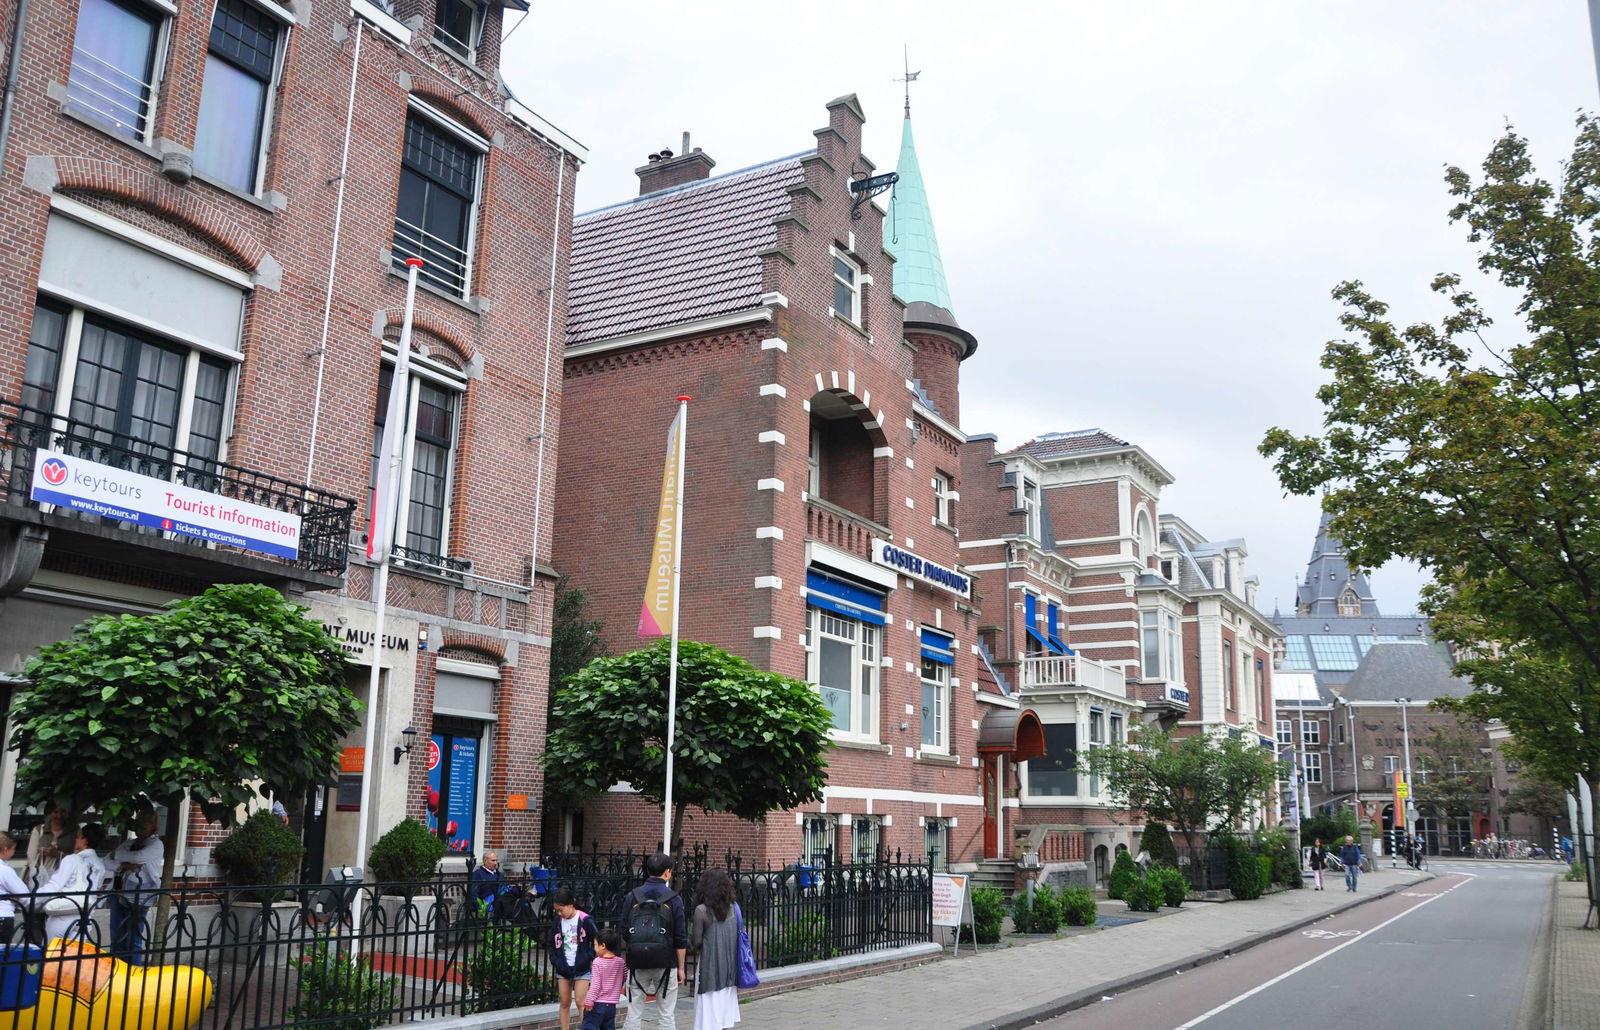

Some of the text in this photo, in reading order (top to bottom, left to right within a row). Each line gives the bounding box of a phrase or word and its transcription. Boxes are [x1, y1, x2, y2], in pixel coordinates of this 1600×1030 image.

[74, 468, 143, 499] keytours
[70, 499, 140, 521] www.keytours.nl
[165, 492, 297, 537] Tourist information
[175, 523, 247, 546] tickets & excursions
[883, 544, 968, 593] COSTER DIAMONDS
